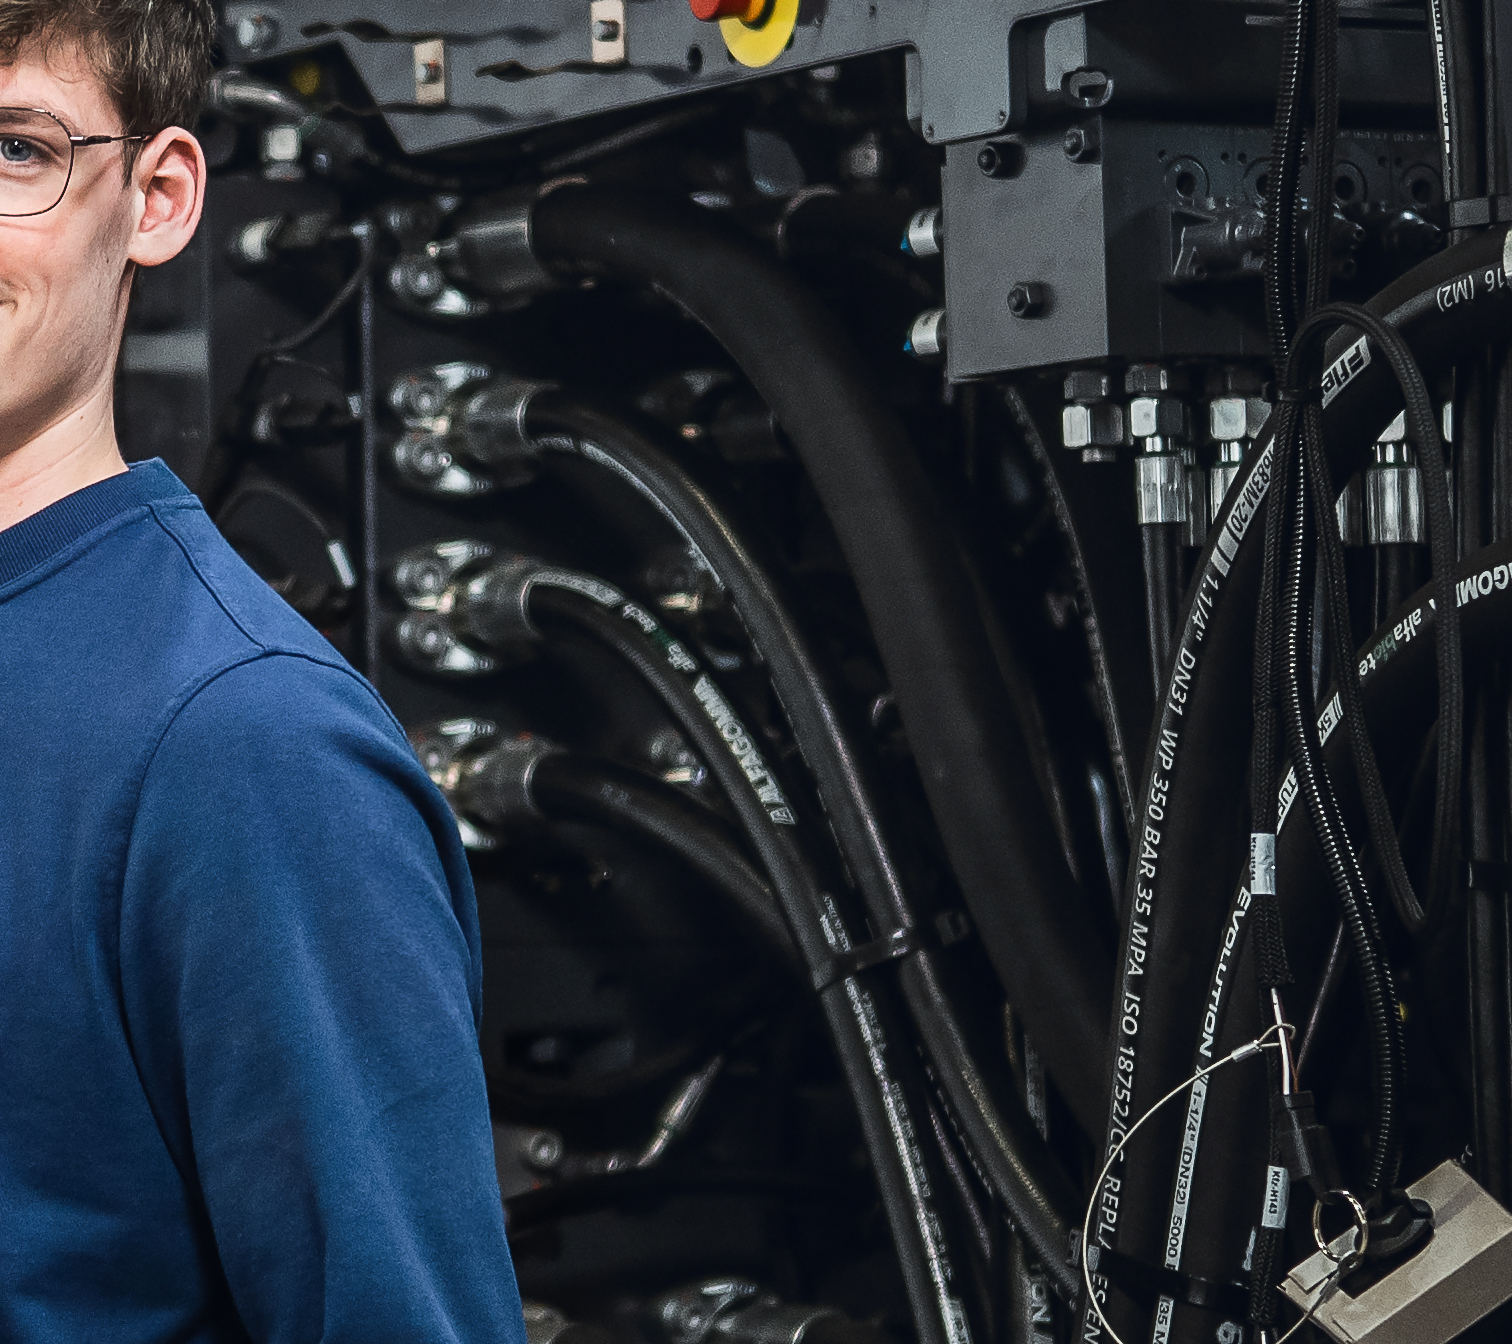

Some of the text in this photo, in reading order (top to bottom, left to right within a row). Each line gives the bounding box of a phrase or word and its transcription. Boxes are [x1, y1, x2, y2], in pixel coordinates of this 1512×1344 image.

[1169, 646, 1197, 716] DN31
[1156, 727, 1178, 771] WP
[1147, 772, 1170, 822] 350
[1135, 826, 1161, 884] BAR
[1132, 883, 1153, 918] 35
[1126, 920, 1150, 977] MPA
[1198, 886, 1253, 1058] EVOLUTION
[1121, 990, 1141, 1036] ISO
[1174, 1146, 1193, 1207] (DN32)
[1166, 1214, 1184, 1260] 5000
